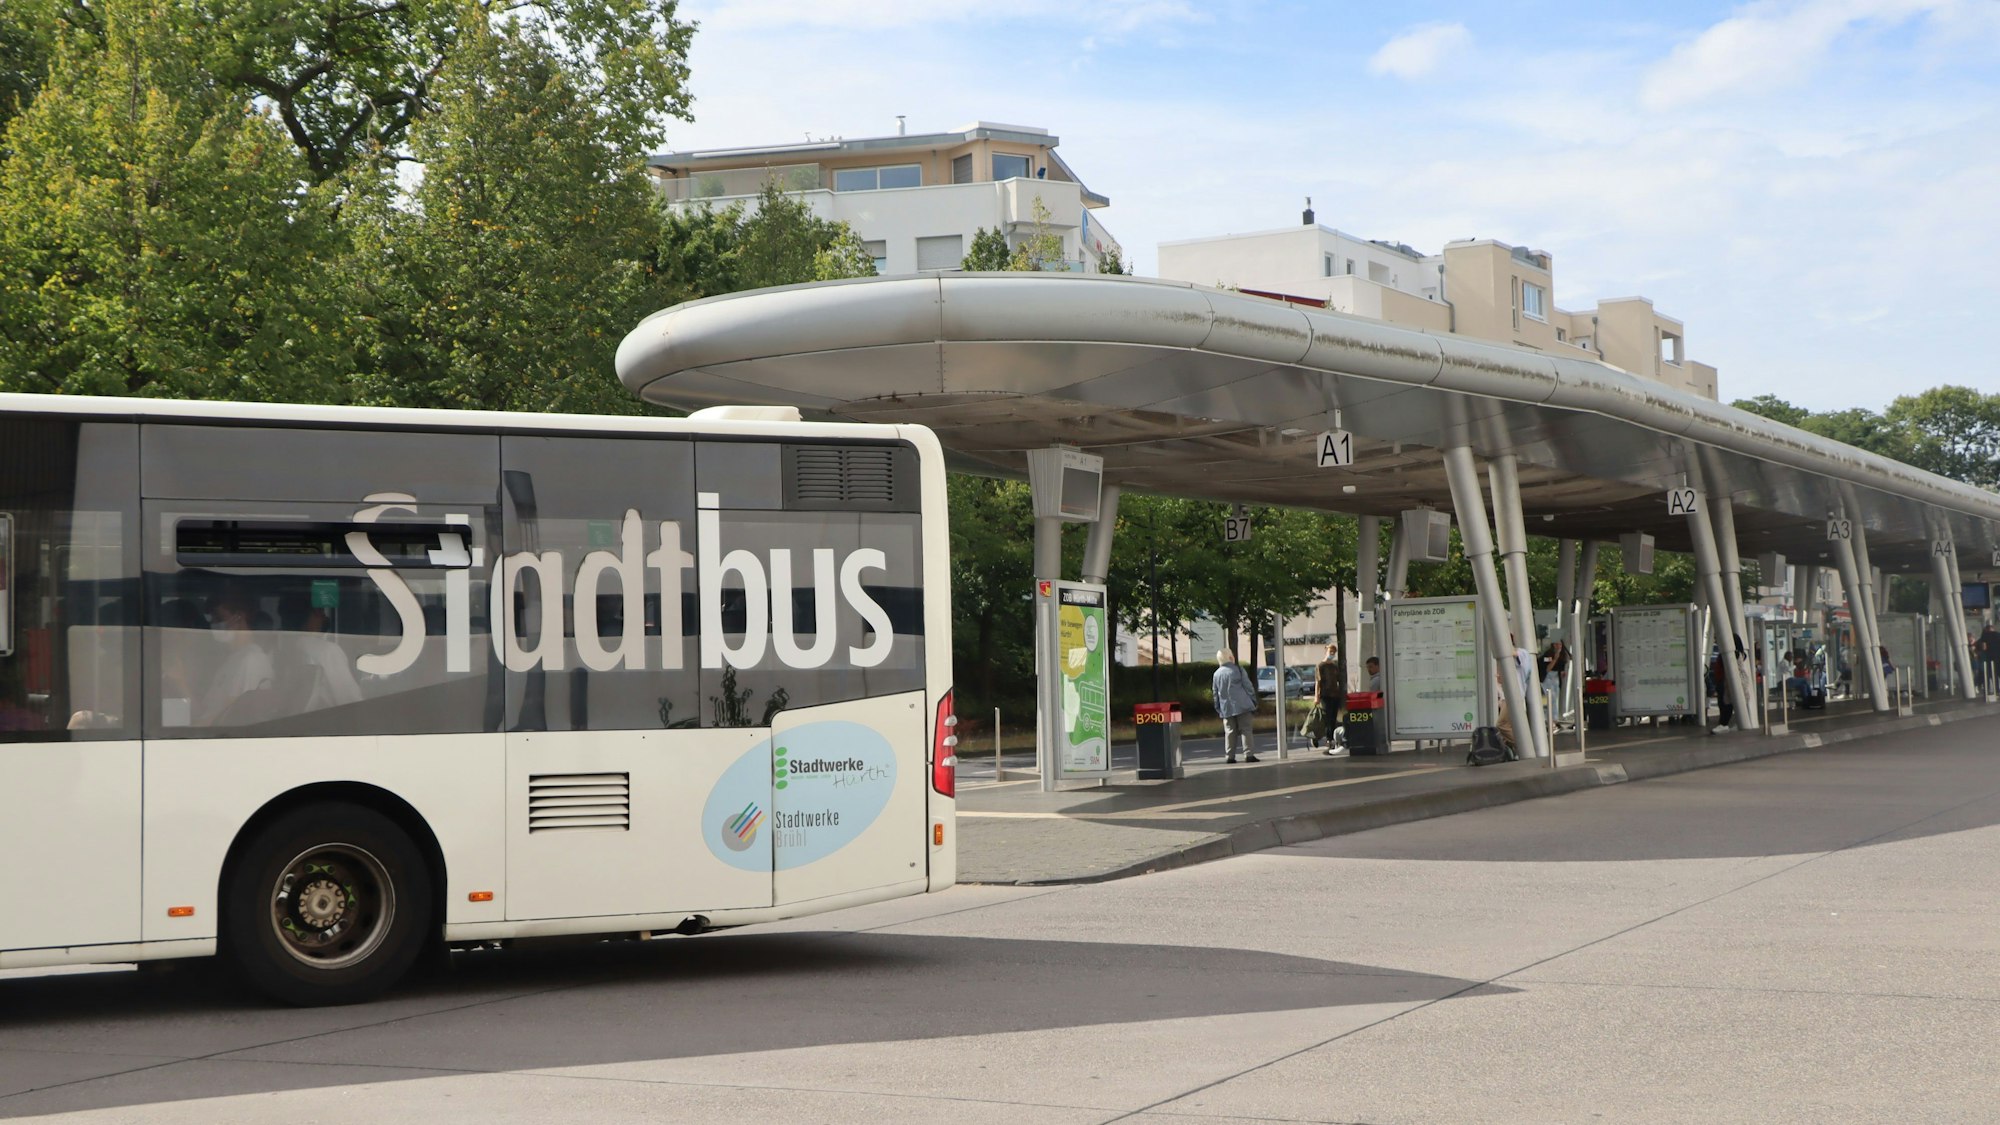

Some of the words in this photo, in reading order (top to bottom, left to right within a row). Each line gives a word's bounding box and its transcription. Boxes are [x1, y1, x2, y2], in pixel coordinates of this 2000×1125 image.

[1320, 433, 1350, 466] A1
[1671, 490, 1696, 514] A2
[1226, 518, 1249, 540] B7
[1829, 520, 1850, 539] A3
[1933, 541, 1952, 556] A4
[345, 491, 894, 674] Stadtbus
[1393, 609, 1423, 617] Fahrpläne
[1136, 712, 1165, 725] B290
[1451, 722, 1472, 731] SWH
[790, 757, 864, 774] Stadtwerke
[775, 808, 839, 829] Stadtwerke
[776, 829, 808, 848] Brühl
